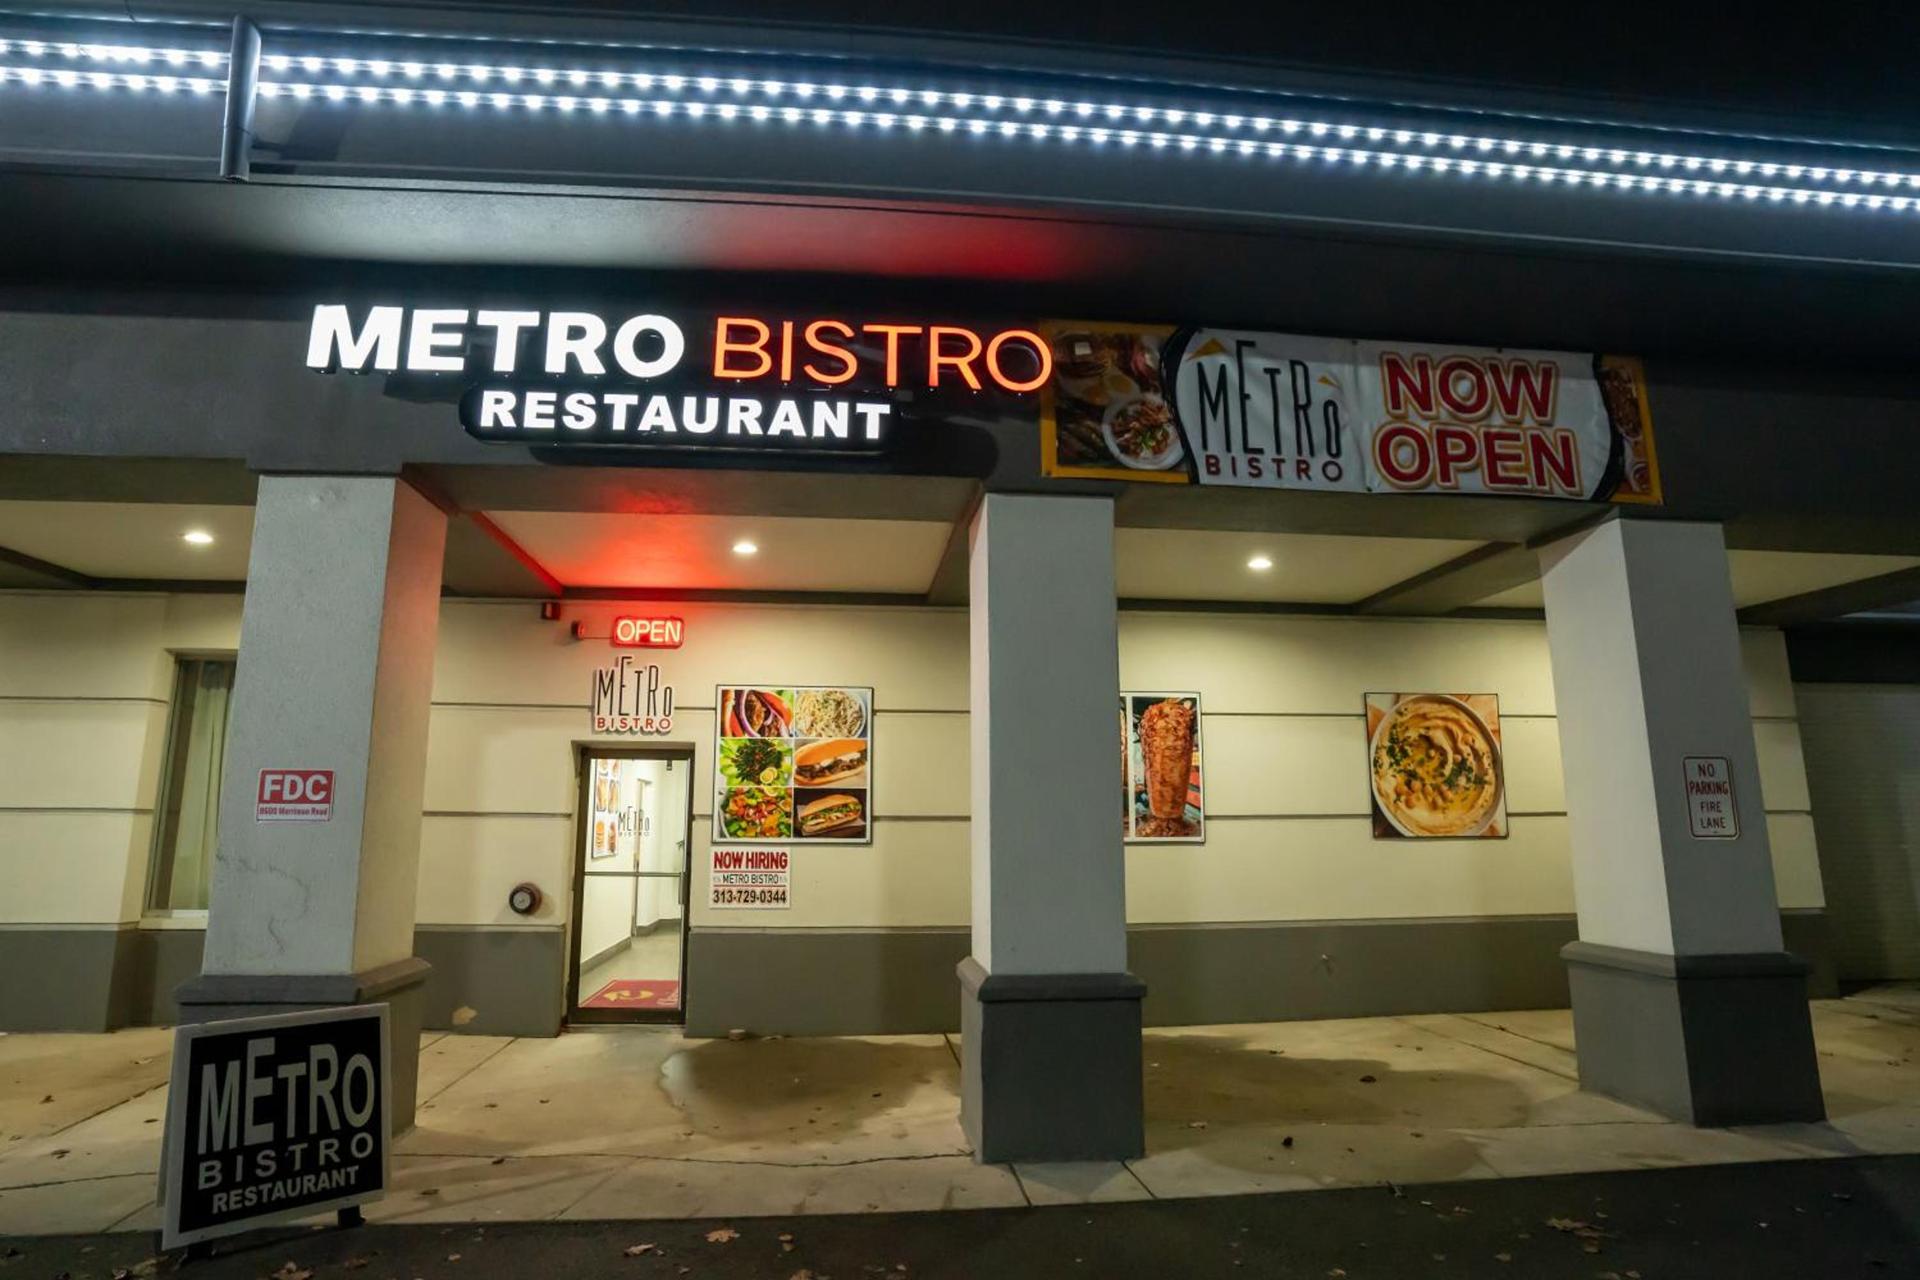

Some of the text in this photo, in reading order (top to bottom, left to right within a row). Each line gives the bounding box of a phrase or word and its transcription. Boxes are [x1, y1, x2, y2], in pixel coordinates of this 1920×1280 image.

[305, 303, 1053, 393] METRO BISTRO
[1197, 340, 1342, 459] METRO
[1382, 353, 1557, 423] NOW
[478, 389, 891, 441] RESTAURANT
[1205, 454, 1343, 482] BISTRO
[1374, 423, 1581, 493] OPEN
[616, 619, 682, 643] OPEN
[597, 655, 673, 718] METRO
[597, 717, 671, 730] BISTRO
[1698, 763, 1715, 777] NO
[263, 774, 328, 801] FDC
[1689, 781, 1729, 796] PARKING
[1700, 801, 1722, 813] FIRE
[1700, 817, 1726, 829] LANE
[714, 851, 788, 870] NOW HIRING
[722, 873, 779, 884] METRO BISTRO
[713, 889, 787, 903] 313-729-0344
[197, 1036, 375, 1155] METRO
[198, 1131, 373, 1190] BISTRO
[212, 1164, 359, 1214] RESTAURANT
